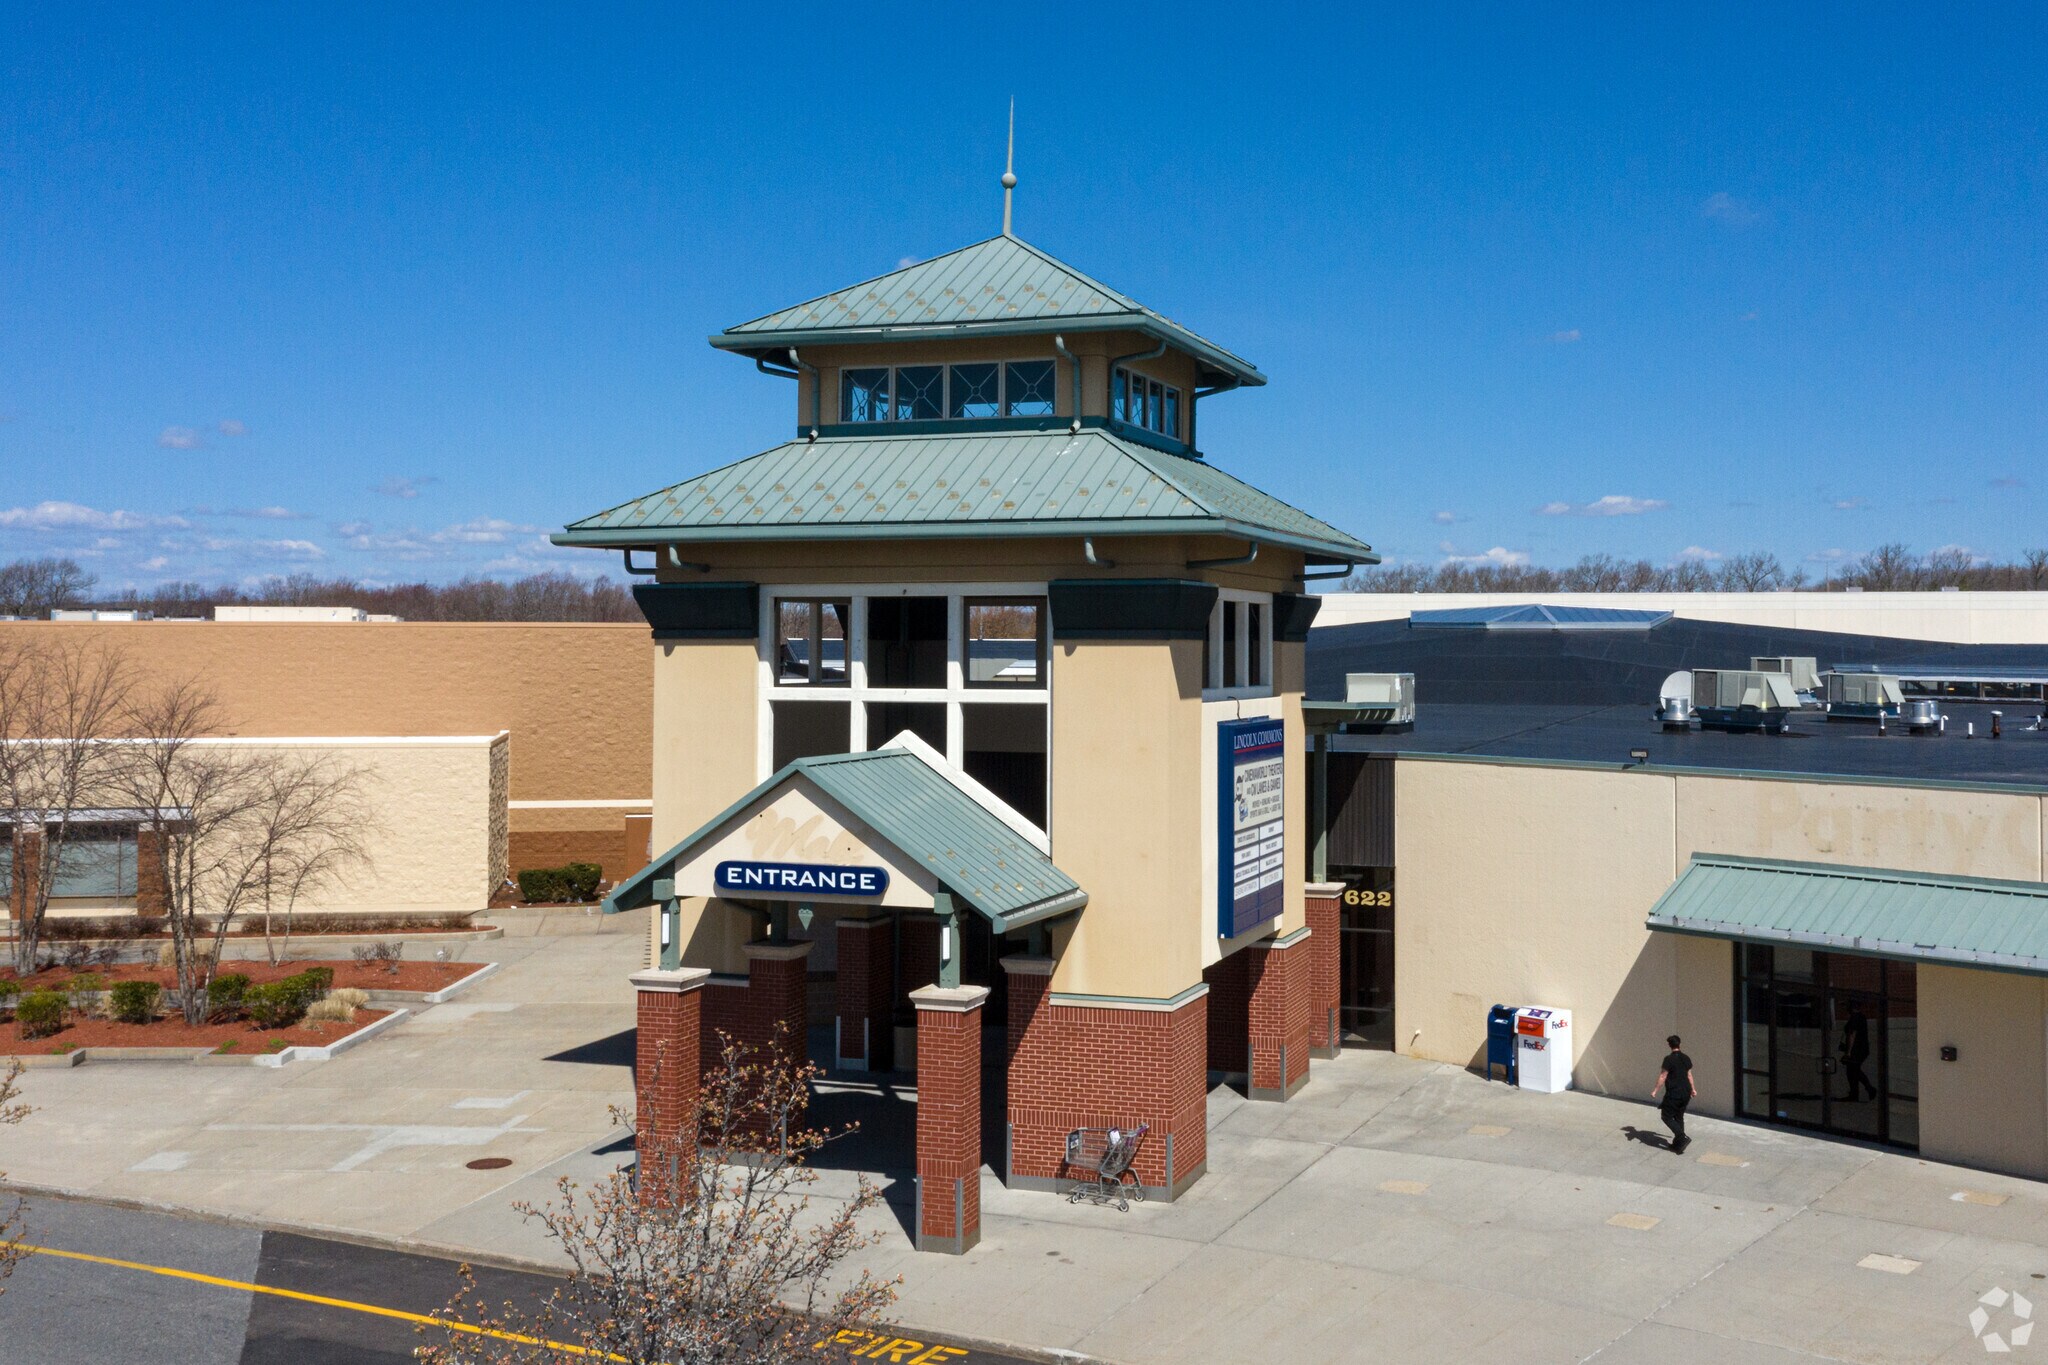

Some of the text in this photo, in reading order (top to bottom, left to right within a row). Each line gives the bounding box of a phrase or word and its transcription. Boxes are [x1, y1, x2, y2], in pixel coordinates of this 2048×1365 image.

[1234, 728, 1283, 750] LINCOLN COMMONS
[727, 867, 876, 890] ENTRANCE
[1344, 890, 1391, 907] 622
[1552, 1019, 1568, 1030] FedEx
[1523, 1039, 1545, 1051] FedEx
[813, 1329, 969, 1365] FIRE
